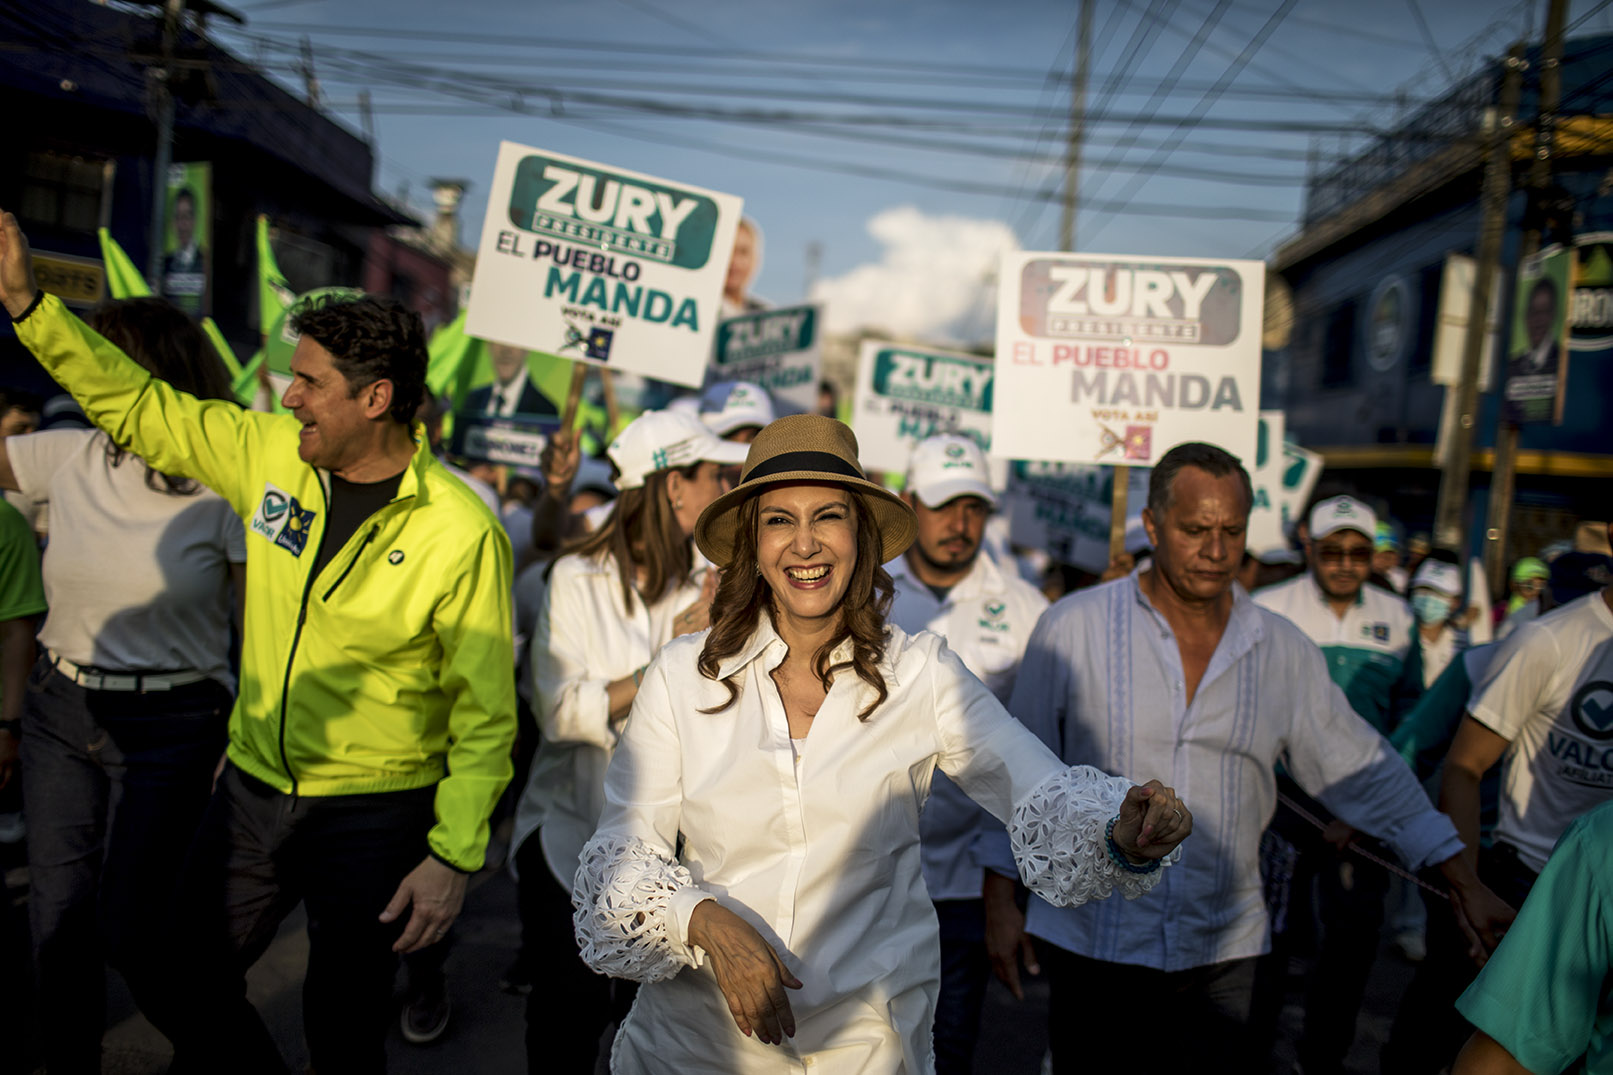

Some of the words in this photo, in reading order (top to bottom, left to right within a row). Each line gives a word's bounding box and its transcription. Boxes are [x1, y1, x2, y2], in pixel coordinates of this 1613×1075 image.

[536, 166, 699, 240] ZURY
[496, 231, 526, 257] EL
[533, 240, 641, 282] PUEBLO
[533, 213, 675, 262] PRESIDENTE
[544, 266, 699, 331] MANDA
[1049, 267, 1217, 320] ZURY
[1051, 320, 1198, 340] PRESIDENTE
[889, 355, 992, 400] ZURY
[1012, 344, 1043, 366] EL
[1052, 346, 1169, 371] PUEBLO
[1071, 372, 1243, 411] MANDA
[1091, 410, 1129, 422] VOTA
